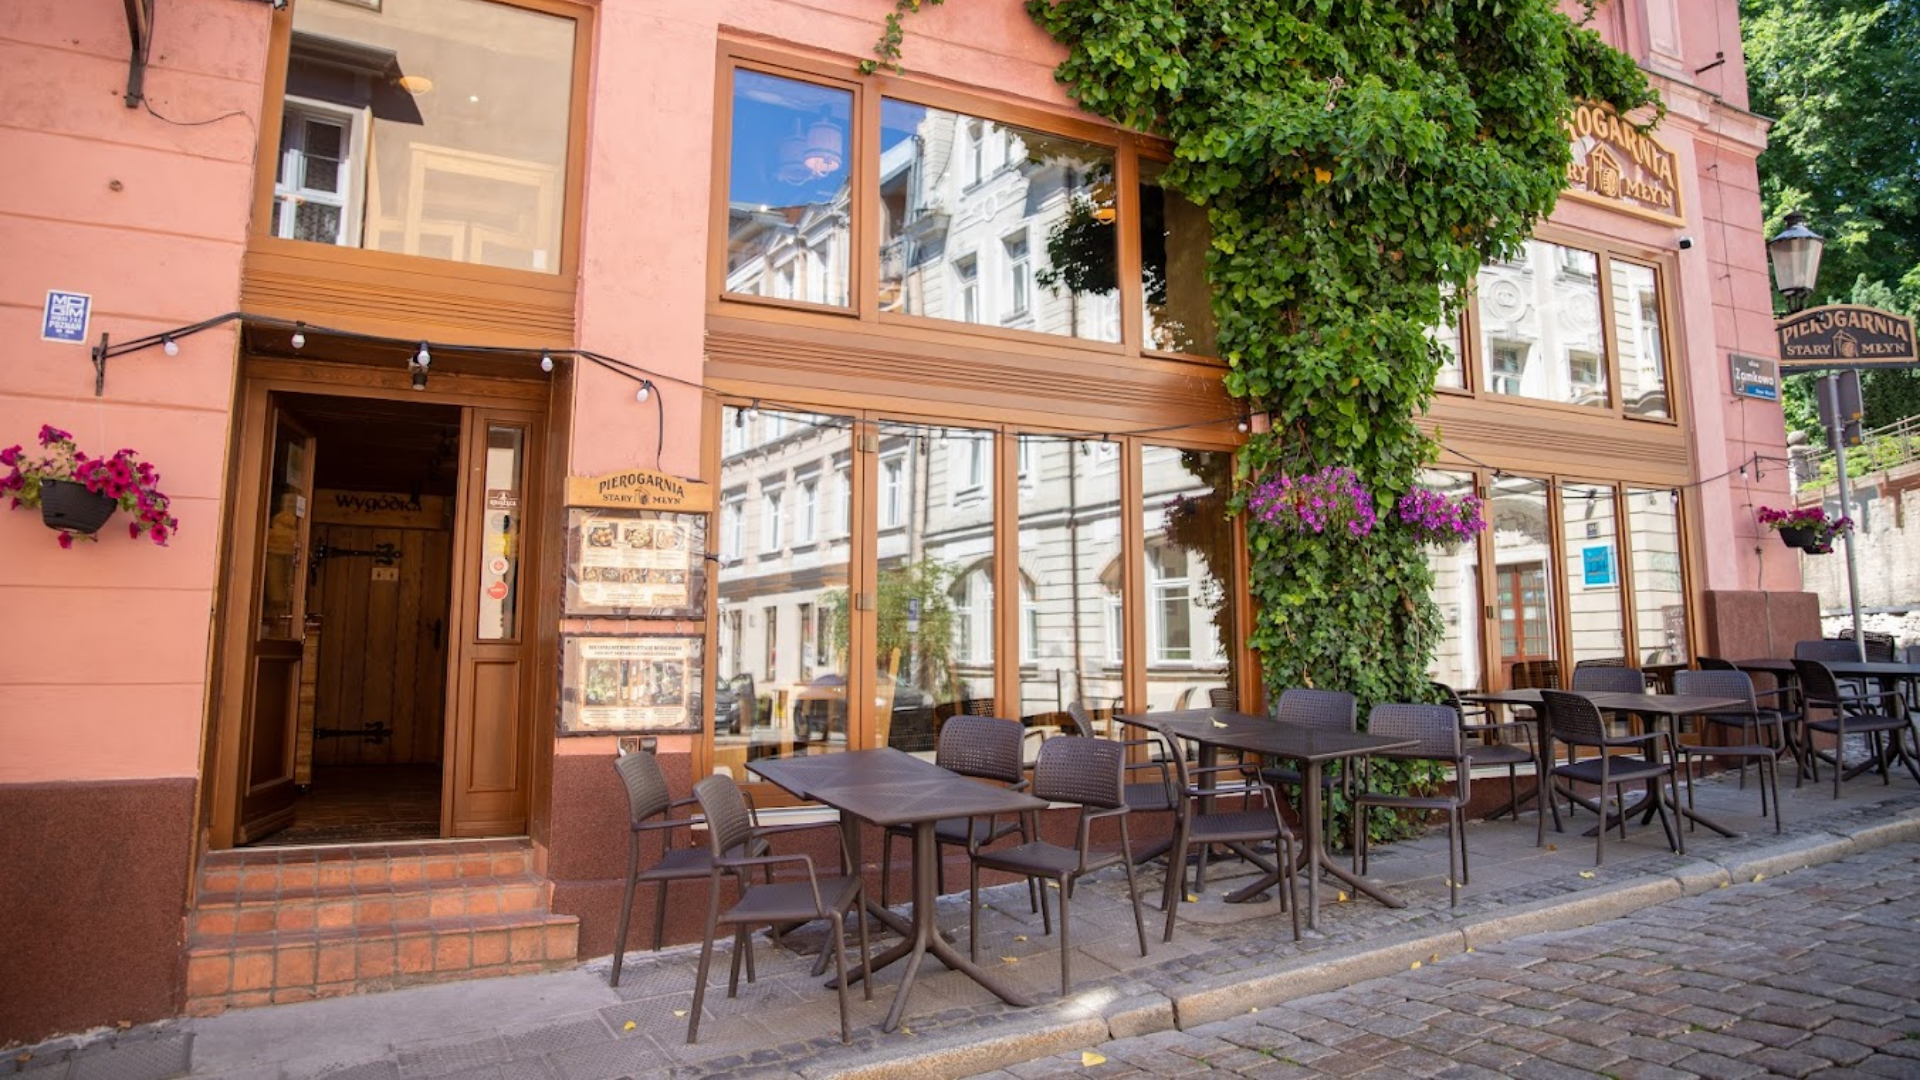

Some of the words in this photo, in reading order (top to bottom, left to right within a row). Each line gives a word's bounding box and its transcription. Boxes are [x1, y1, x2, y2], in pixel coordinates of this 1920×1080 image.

[1566, 162, 1590, 184] RY
[1625, 177, 1673, 207] MŁYN
[1786, 344, 1832, 356] STARY
[1861, 342, 1906, 354] MŁYN
[1735, 367, 1775, 386] Zamkowa
[599, 473, 685, 498] PIEROGARNIA
[603, 493, 633, 503] STARY
[653, 495, 681, 505] MŁYN
